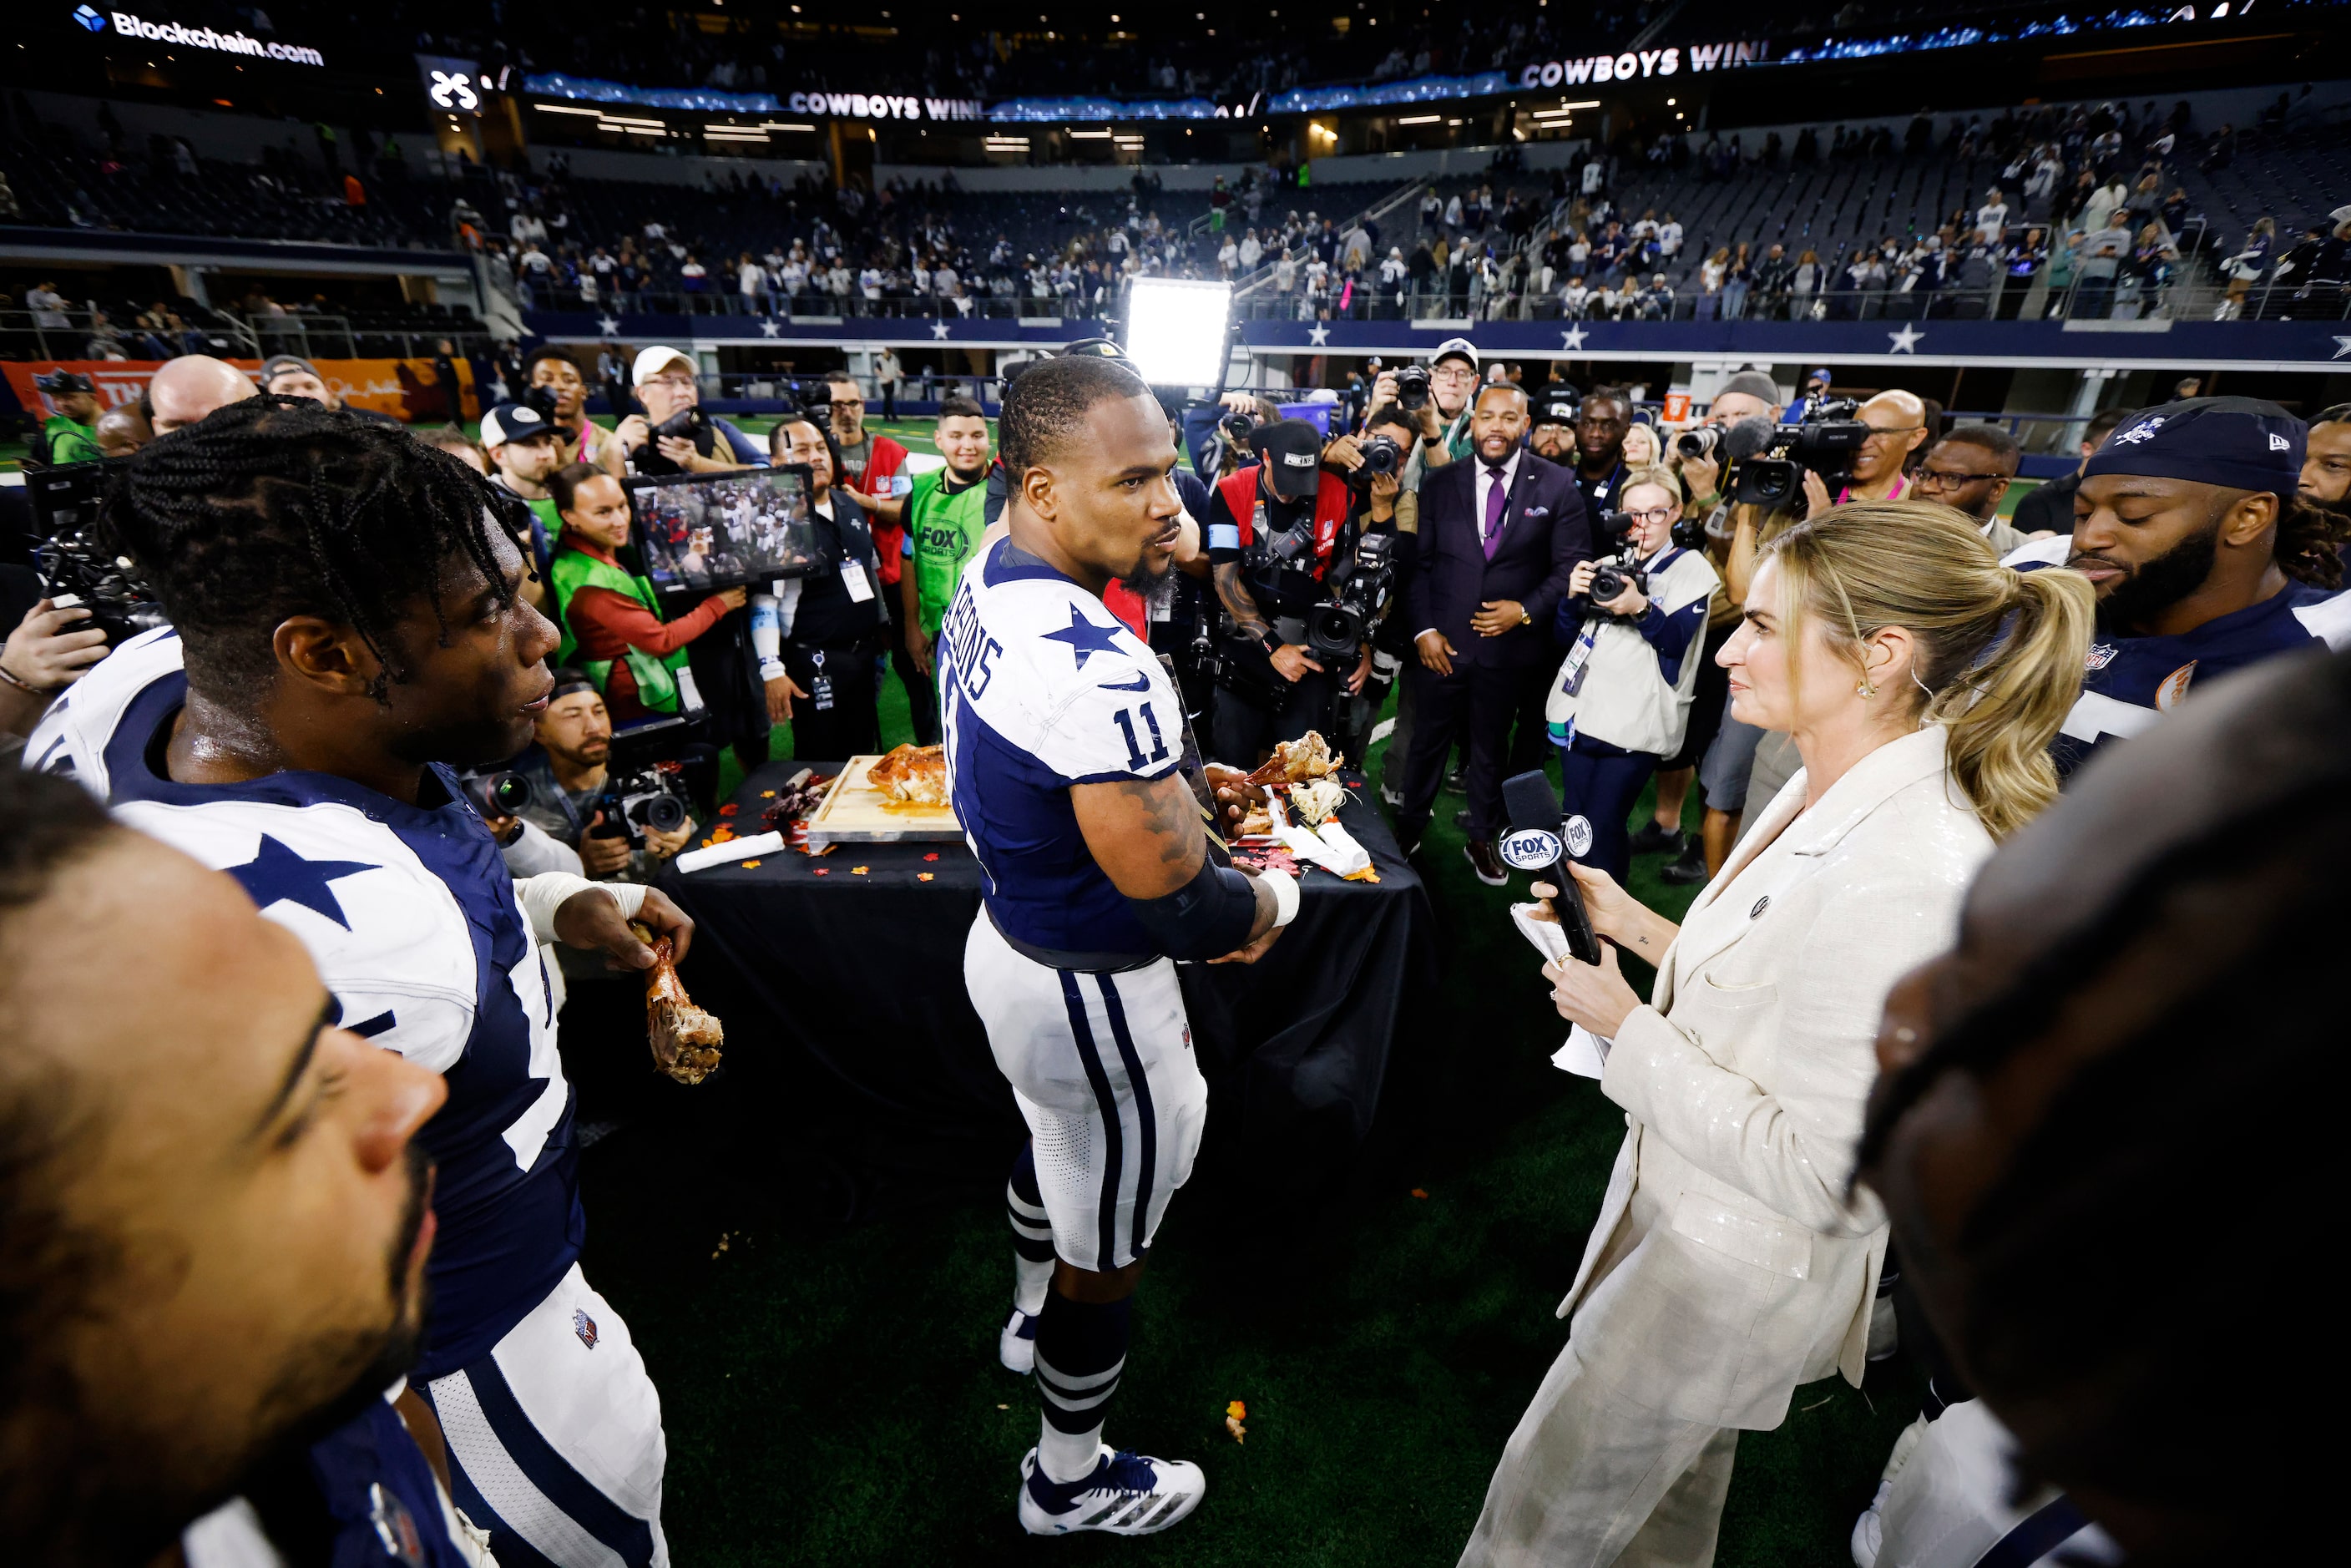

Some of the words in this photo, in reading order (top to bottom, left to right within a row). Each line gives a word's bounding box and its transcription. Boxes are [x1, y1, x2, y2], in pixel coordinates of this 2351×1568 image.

[110, 11, 325, 67] Blockchain.com
[1519, 47, 1681, 89] COWBOYS
[789, 91, 921, 120] COWBOYS
[920, 526, 957, 549] FOX
[1113, 701, 1170, 772] 11
[1570, 821, 1587, 844] FOX
[1573, 836, 1589, 850] SPORTS
[1511, 836, 1549, 856] FOX
[1515, 851, 1550, 862] SPORTS
